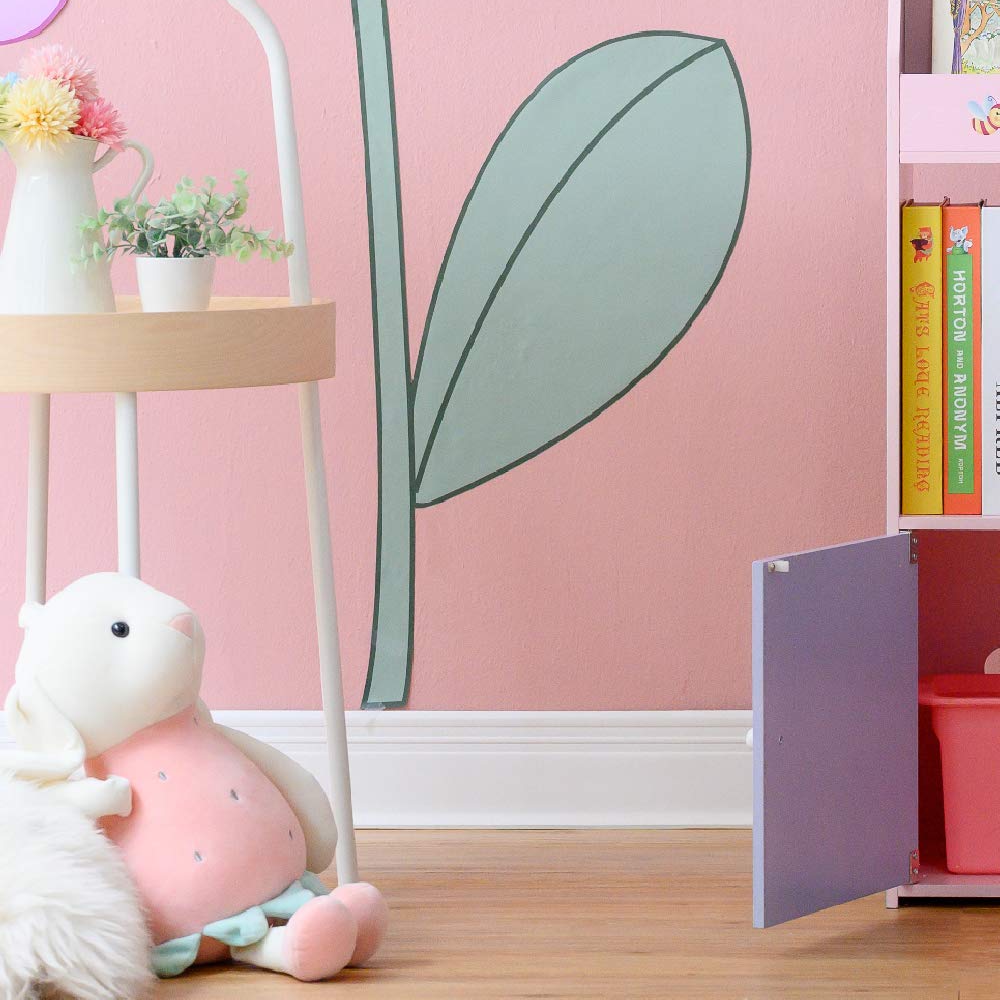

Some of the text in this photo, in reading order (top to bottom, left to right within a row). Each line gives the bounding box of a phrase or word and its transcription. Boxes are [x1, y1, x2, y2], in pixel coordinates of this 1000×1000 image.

[952, 270, 967, 343] HORTON
[955, 349, 964, 369] AND
[952, 373, 967, 451] ANONYM
